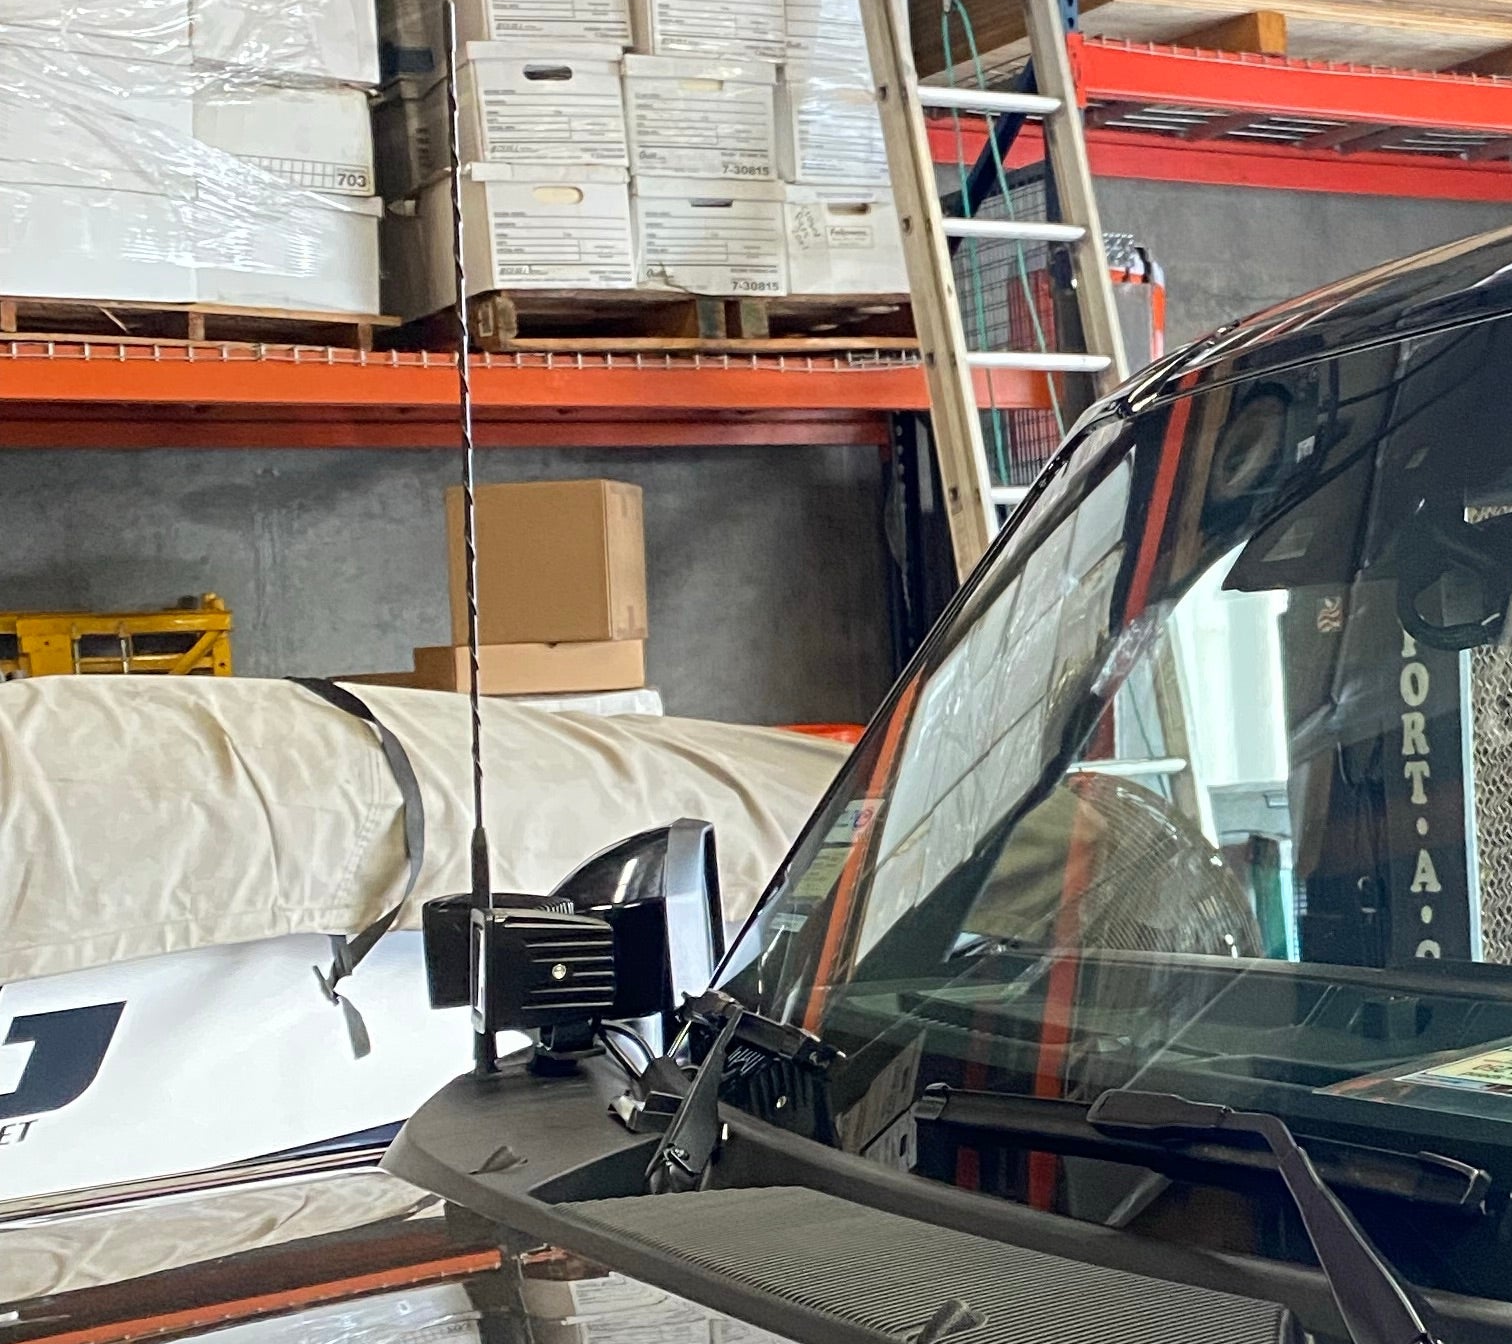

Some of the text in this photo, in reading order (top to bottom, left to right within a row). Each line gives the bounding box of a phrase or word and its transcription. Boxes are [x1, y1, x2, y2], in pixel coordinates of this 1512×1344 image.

[722, 165, 770, 176] 7-30815
[337, 172, 368, 188] 703
[731, 281, 779, 291] 7-30815
